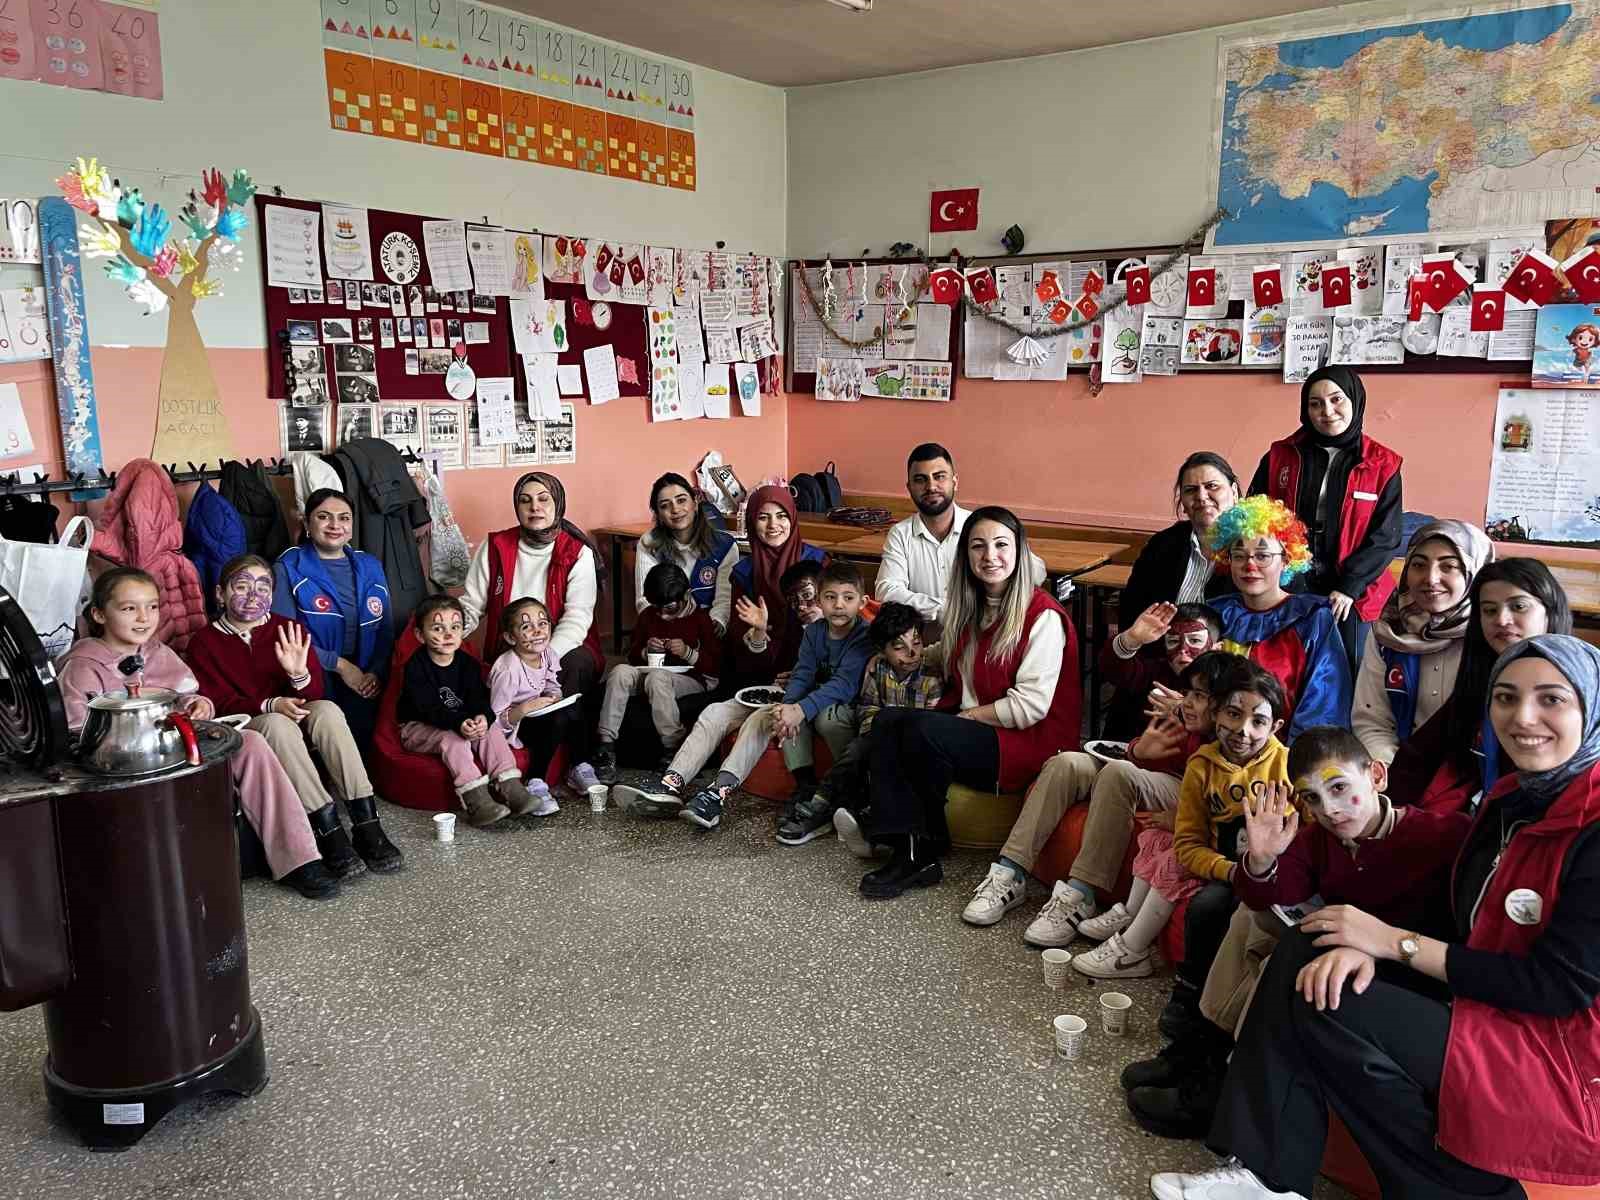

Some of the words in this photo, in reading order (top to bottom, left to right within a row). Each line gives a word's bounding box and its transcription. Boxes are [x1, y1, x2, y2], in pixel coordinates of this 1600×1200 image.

[47, 0, 84, 29] 36
[429, 0, 441, 30] 9
[467, 8, 492, 43] 12
[507, 22, 529, 51] 15
[544, 31, 564, 62] 18
[577, 44, 597, 73] 21
[641, 61, 661, 85] 27
[672, 72, 690, 96] 30
[343, 62, 358, 85] 5
[386, 68, 406, 93] 10
[429, 78, 450, 104] 15
[472, 87, 491, 110] 20
[161, 398, 224, 416] DOSTLUK
